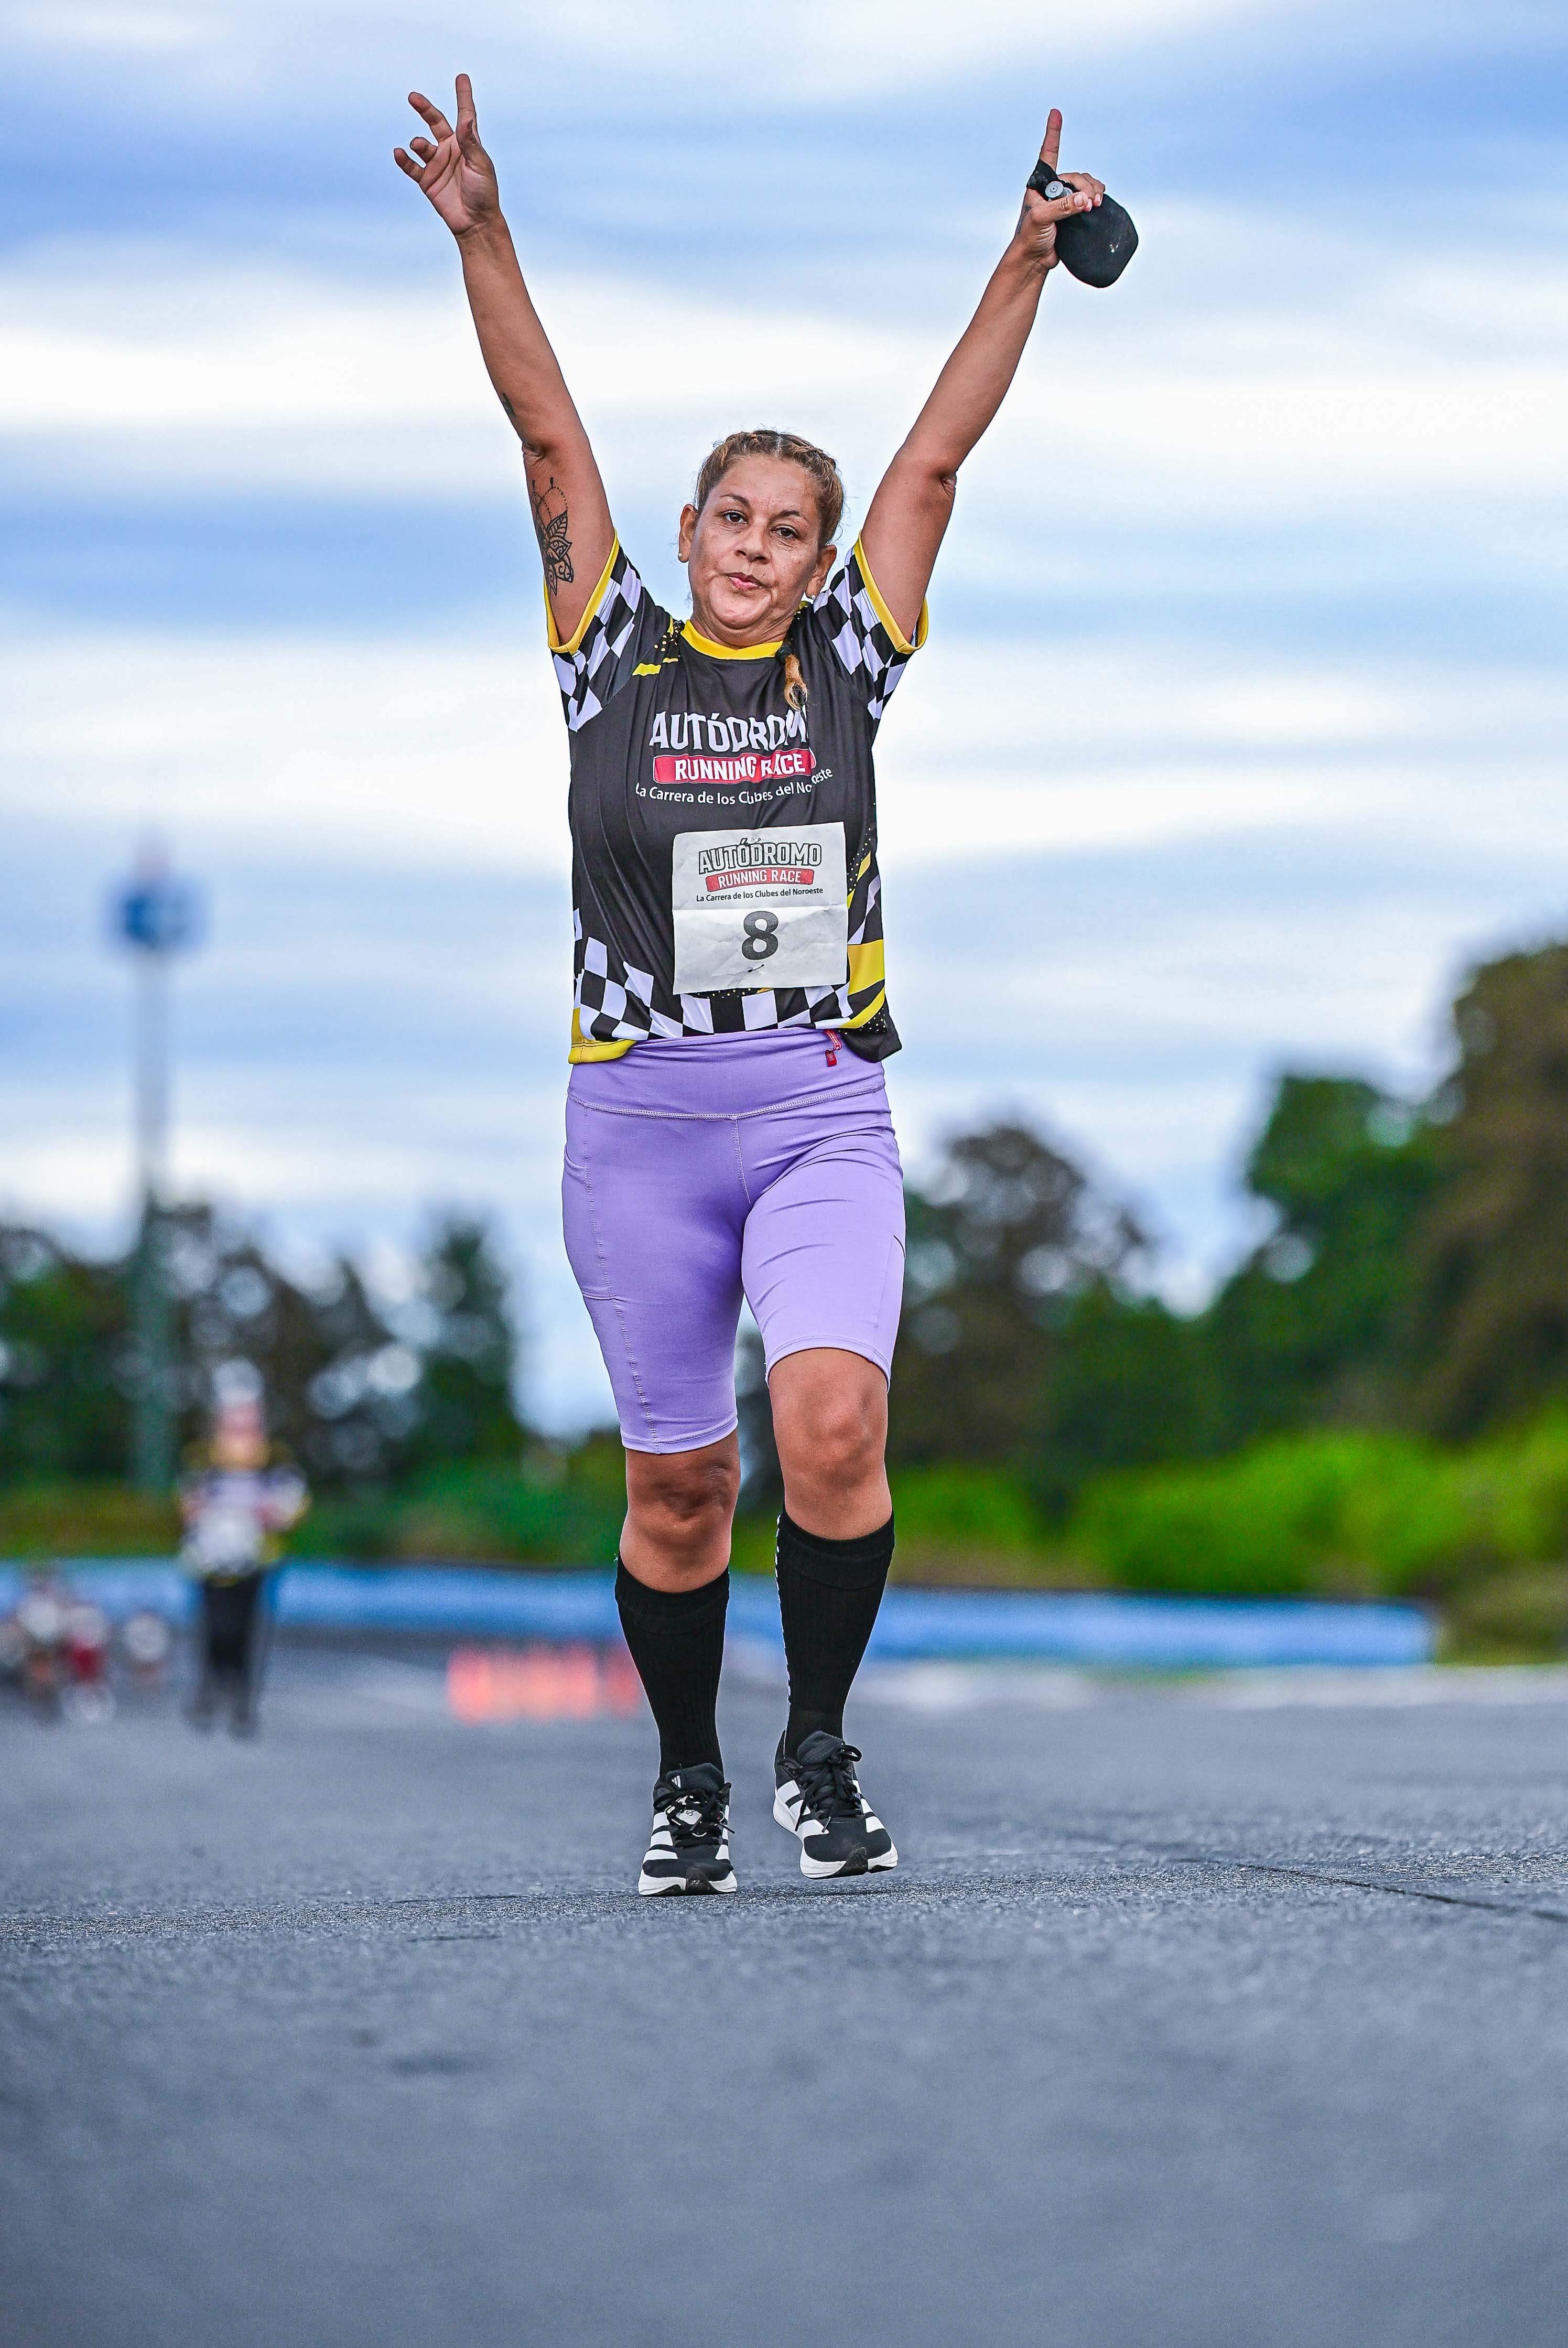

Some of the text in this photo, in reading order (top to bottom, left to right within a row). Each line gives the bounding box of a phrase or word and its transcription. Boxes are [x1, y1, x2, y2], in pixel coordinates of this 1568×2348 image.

[675, 753, 806, 780] RUNNING RACE
[635, 782, 646, 798] La
[649, 787, 694, 803] Carrera
[697, 791, 714, 804] de
[718, 792, 736, 805] los
[738, 791, 773, 804] Clubes
[775, 782, 794, 796] del
[698, 837, 822, 875] AUTÓDROMO
[717, 869, 802, 888] RUNNING RACE
[742, 911, 778, 961] 8
